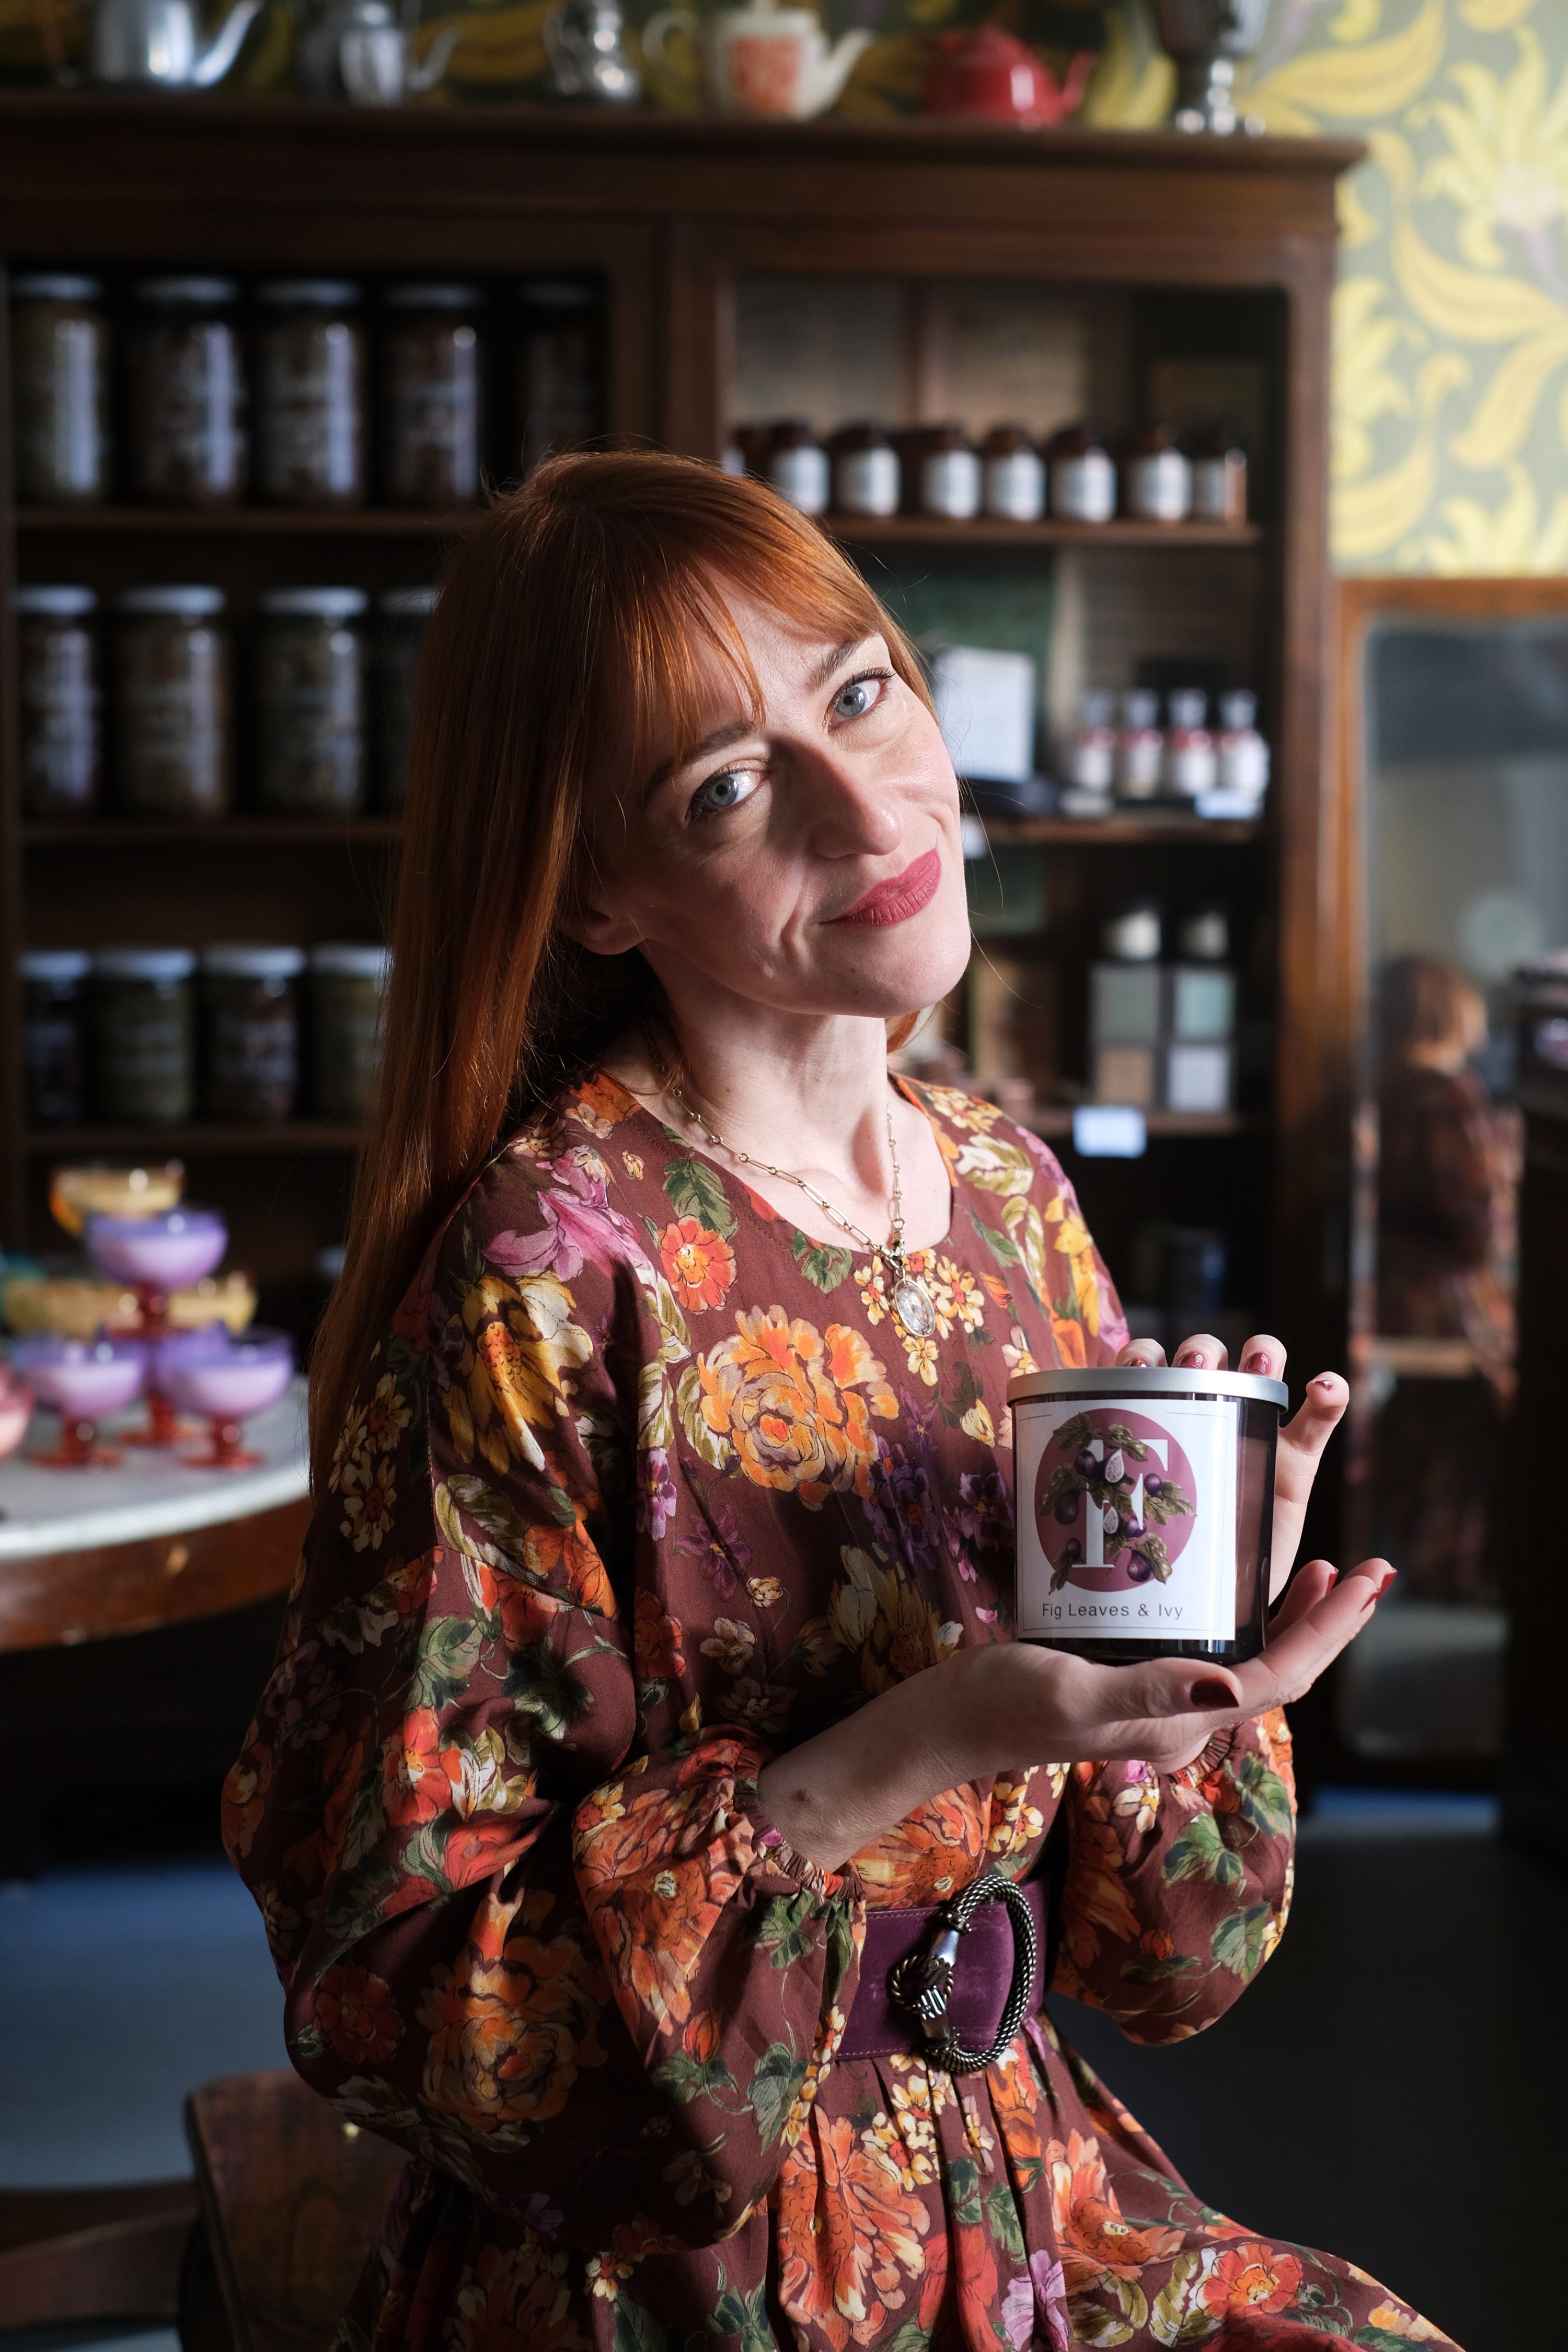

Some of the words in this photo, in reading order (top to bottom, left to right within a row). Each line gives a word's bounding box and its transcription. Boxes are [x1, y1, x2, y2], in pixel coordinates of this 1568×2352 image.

[1071, 1439, 1168, 1568] F
[1042, 1603, 1062, 1620] Fig
[1068, 1603, 1129, 1617] Leaves
[1138, 1603, 1149, 1617] &
[1158, 1604, 1183, 1620] Ivy
